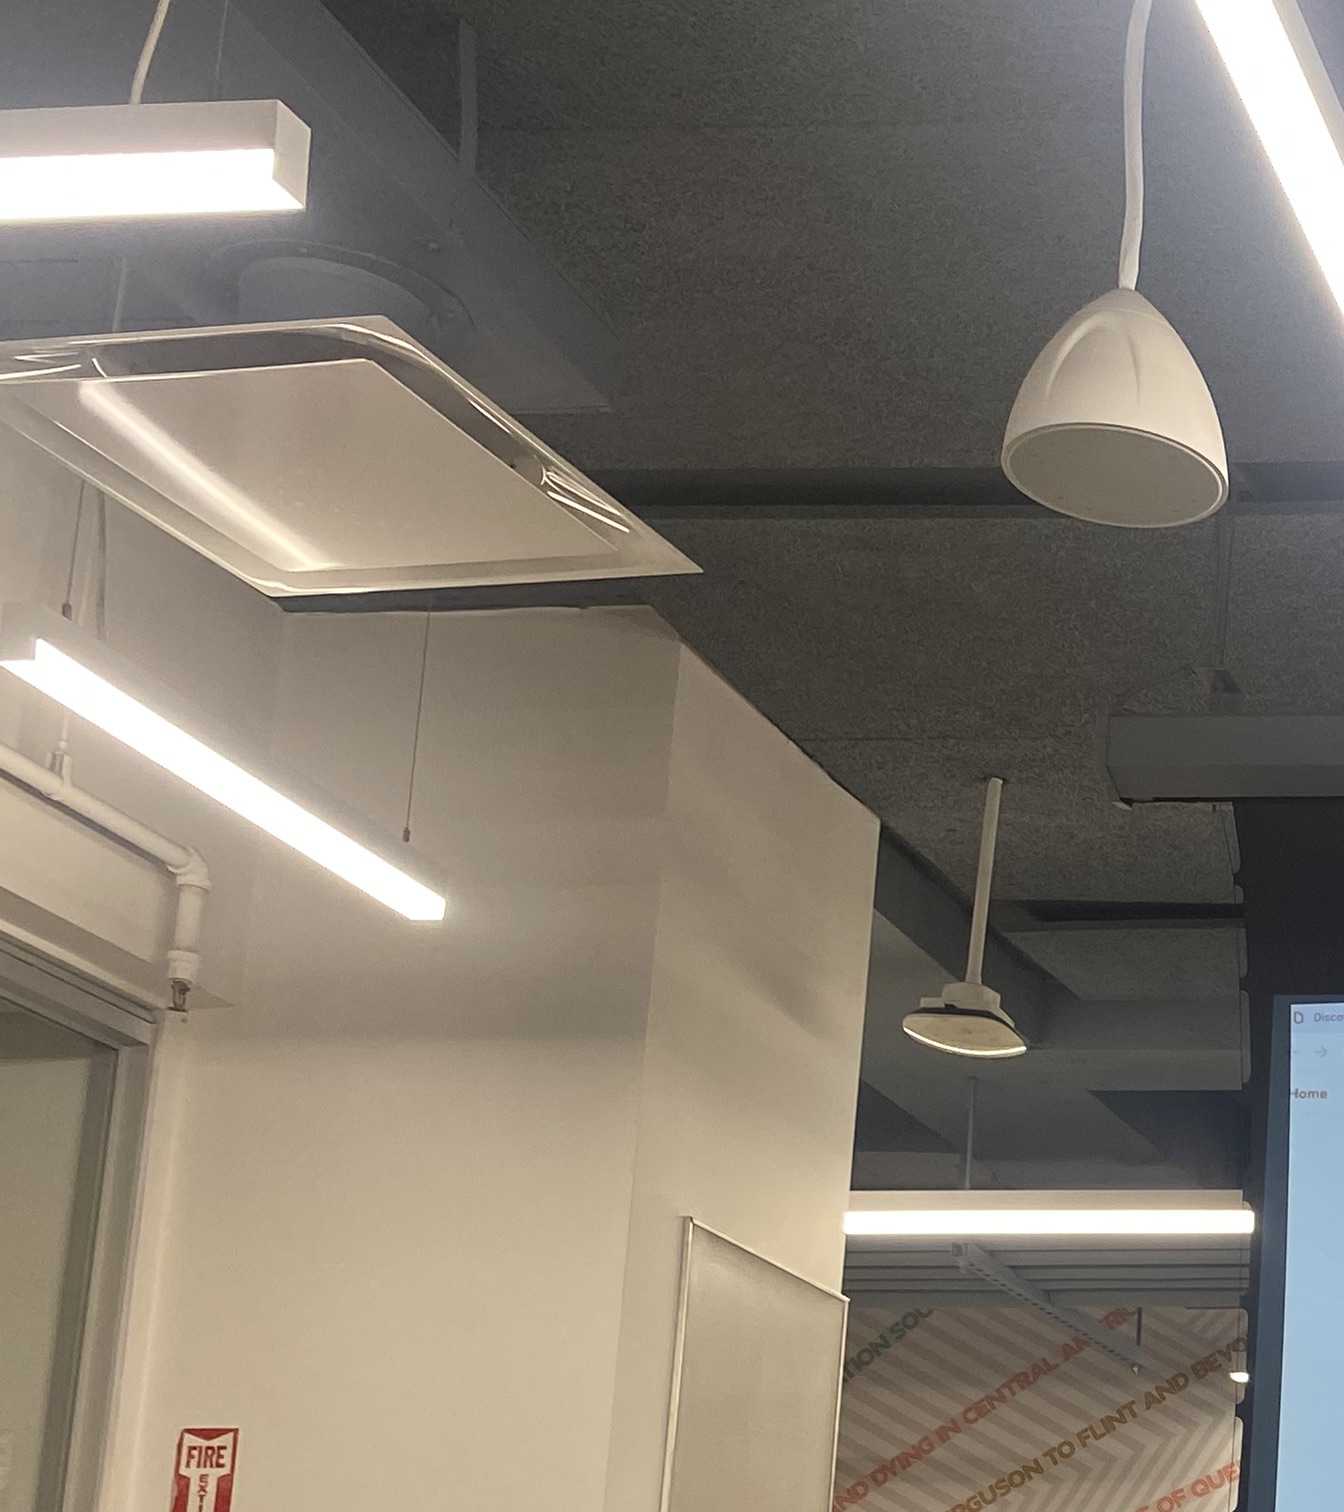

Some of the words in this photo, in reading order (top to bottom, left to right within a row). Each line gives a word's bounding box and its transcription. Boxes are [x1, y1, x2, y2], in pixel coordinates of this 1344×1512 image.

[185, 1445, 228, 1469] FIRE
[869, 1434, 937, 1489] DYING
[934, 1417, 963, 1446] IN
[961, 1357, 1060, 1428] CENTRAL
[1043, 1439, 1077, 1466] TO
[1075, 1400, 1140, 1450] FLINT
[1143, 1371, 1190, 1411] AND
